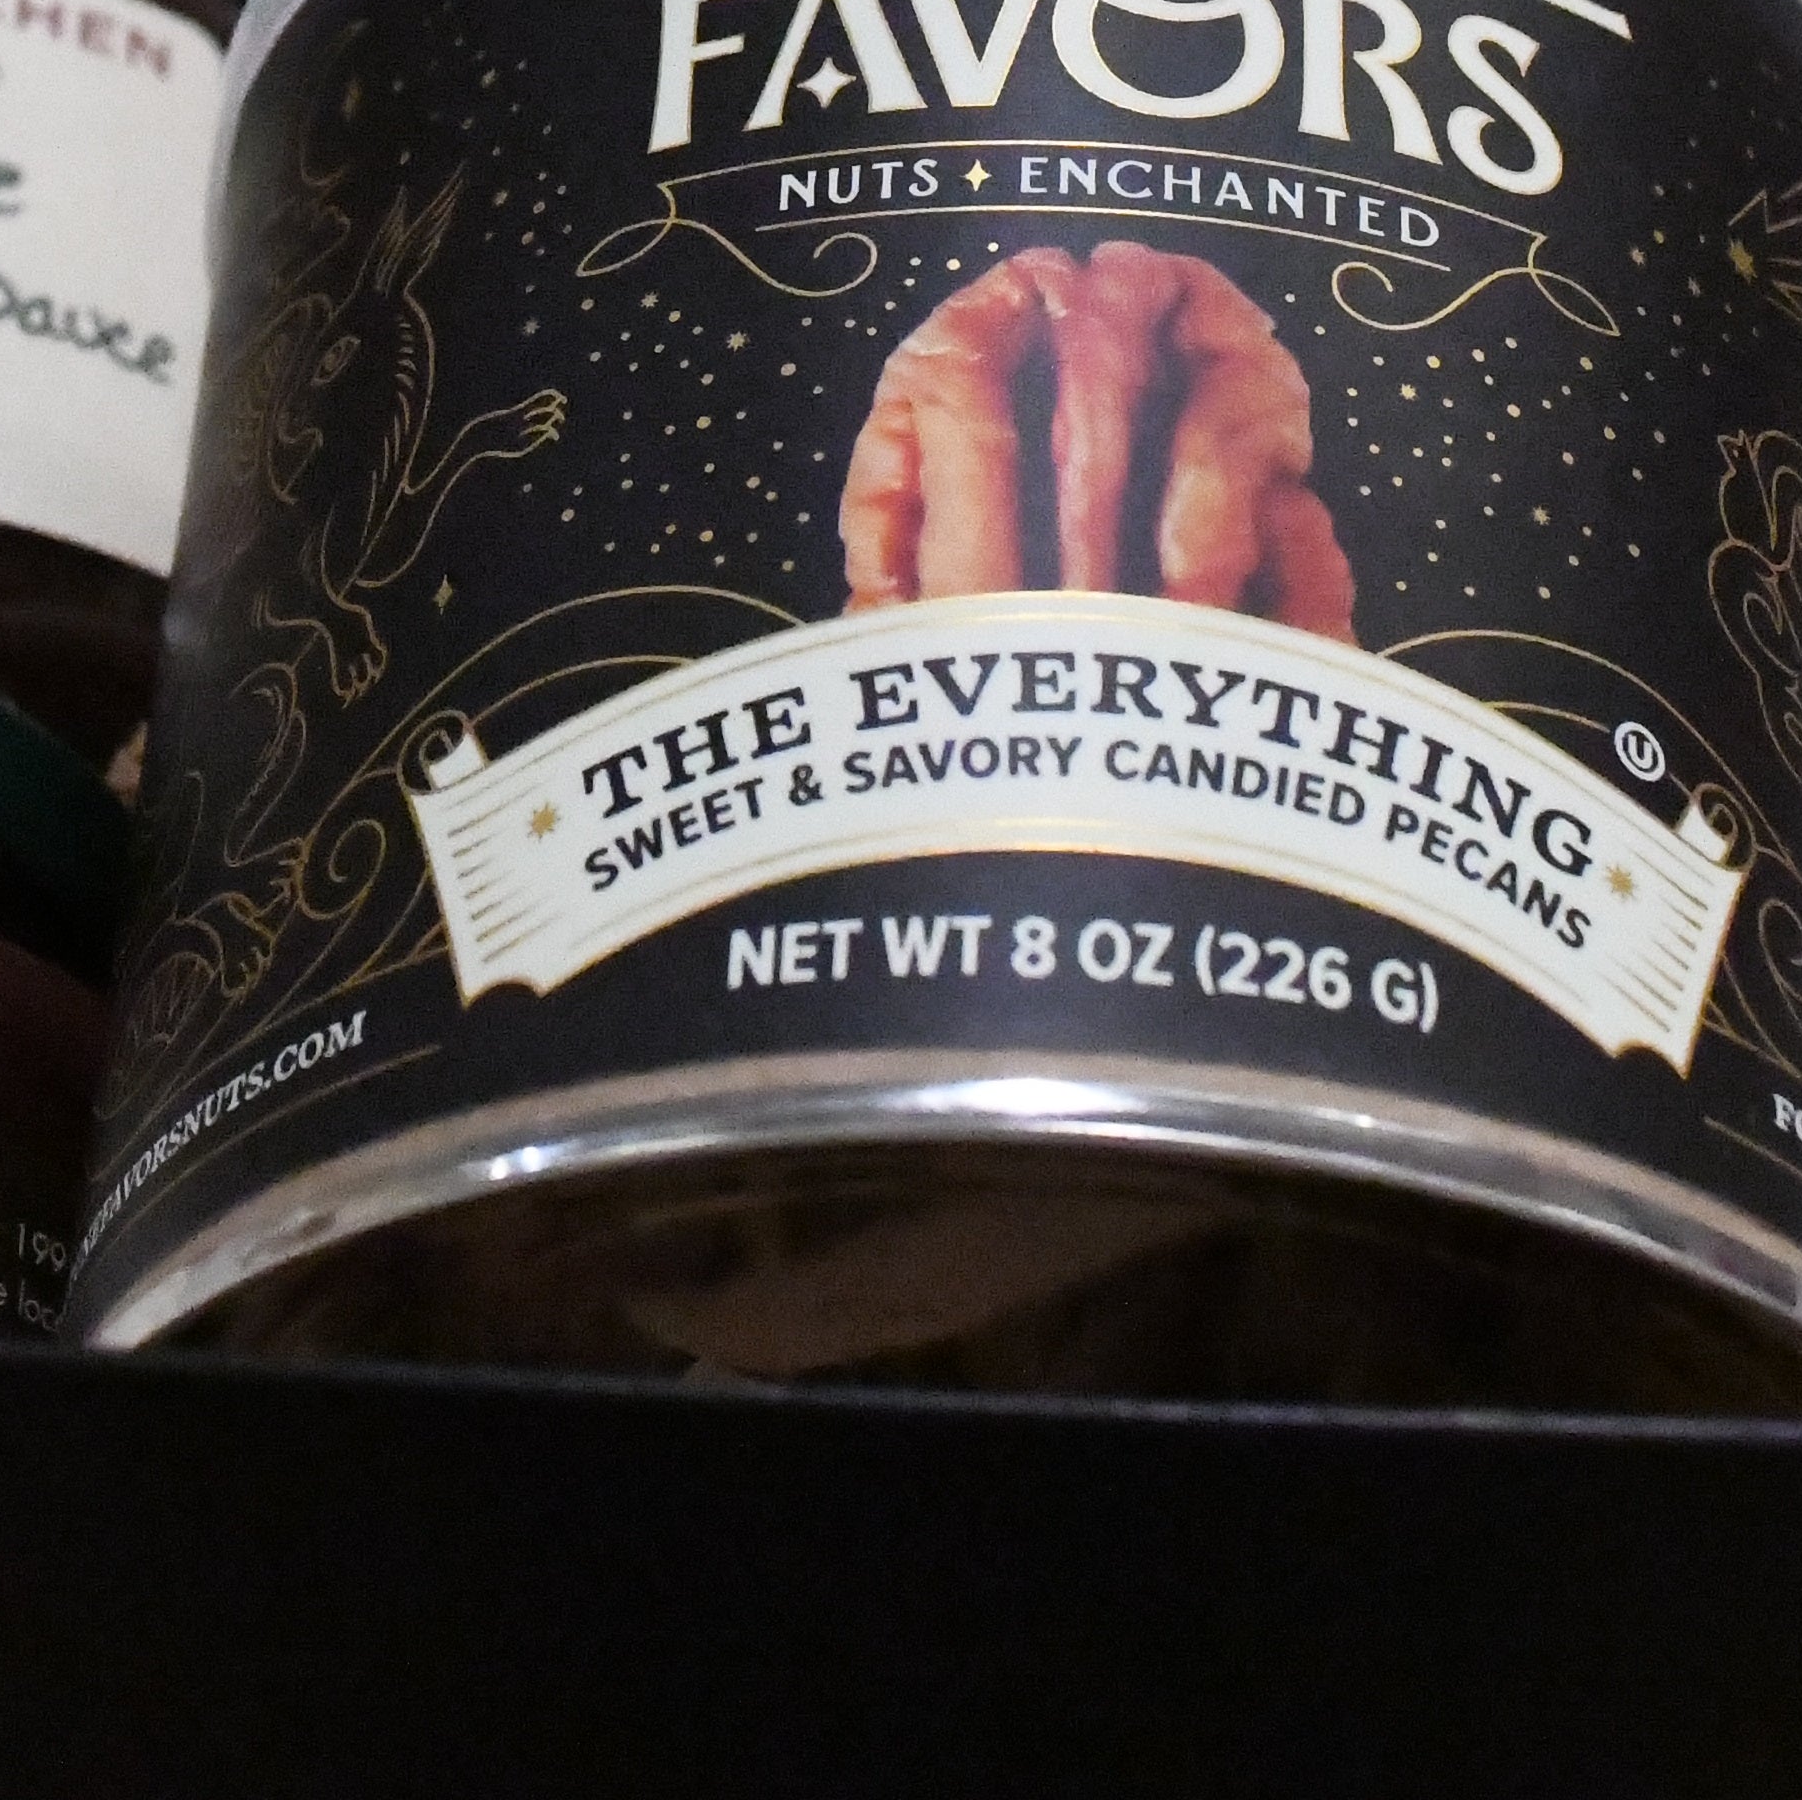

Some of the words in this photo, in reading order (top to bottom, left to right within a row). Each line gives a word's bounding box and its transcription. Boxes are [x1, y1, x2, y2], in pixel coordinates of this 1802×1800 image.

[777, 157, 942, 211] NUTS
[1020, 156, 1440, 251] ENCHANTED
[581, 686, 813, 820] THE
[848, 651, 1595, 877] EVERYTHING
[583, 776, 764, 892] SWEET
[788, 762, 825, 807] &
[844, 735, 1083, 795] SAVORY
[1103, 737, 1367, 826] CANDIED
[1383, 802, 1592, 949] PECANS
[724, 918, 864, 993] NET
[882, 913, 987, 978] WT
[1010, 914, 1058, 979] 8
[1077, 917, 1176, 988] OZ
[1196, 926, 1354, 1013] (226
[1372, 952, 1441, 1034] G)
